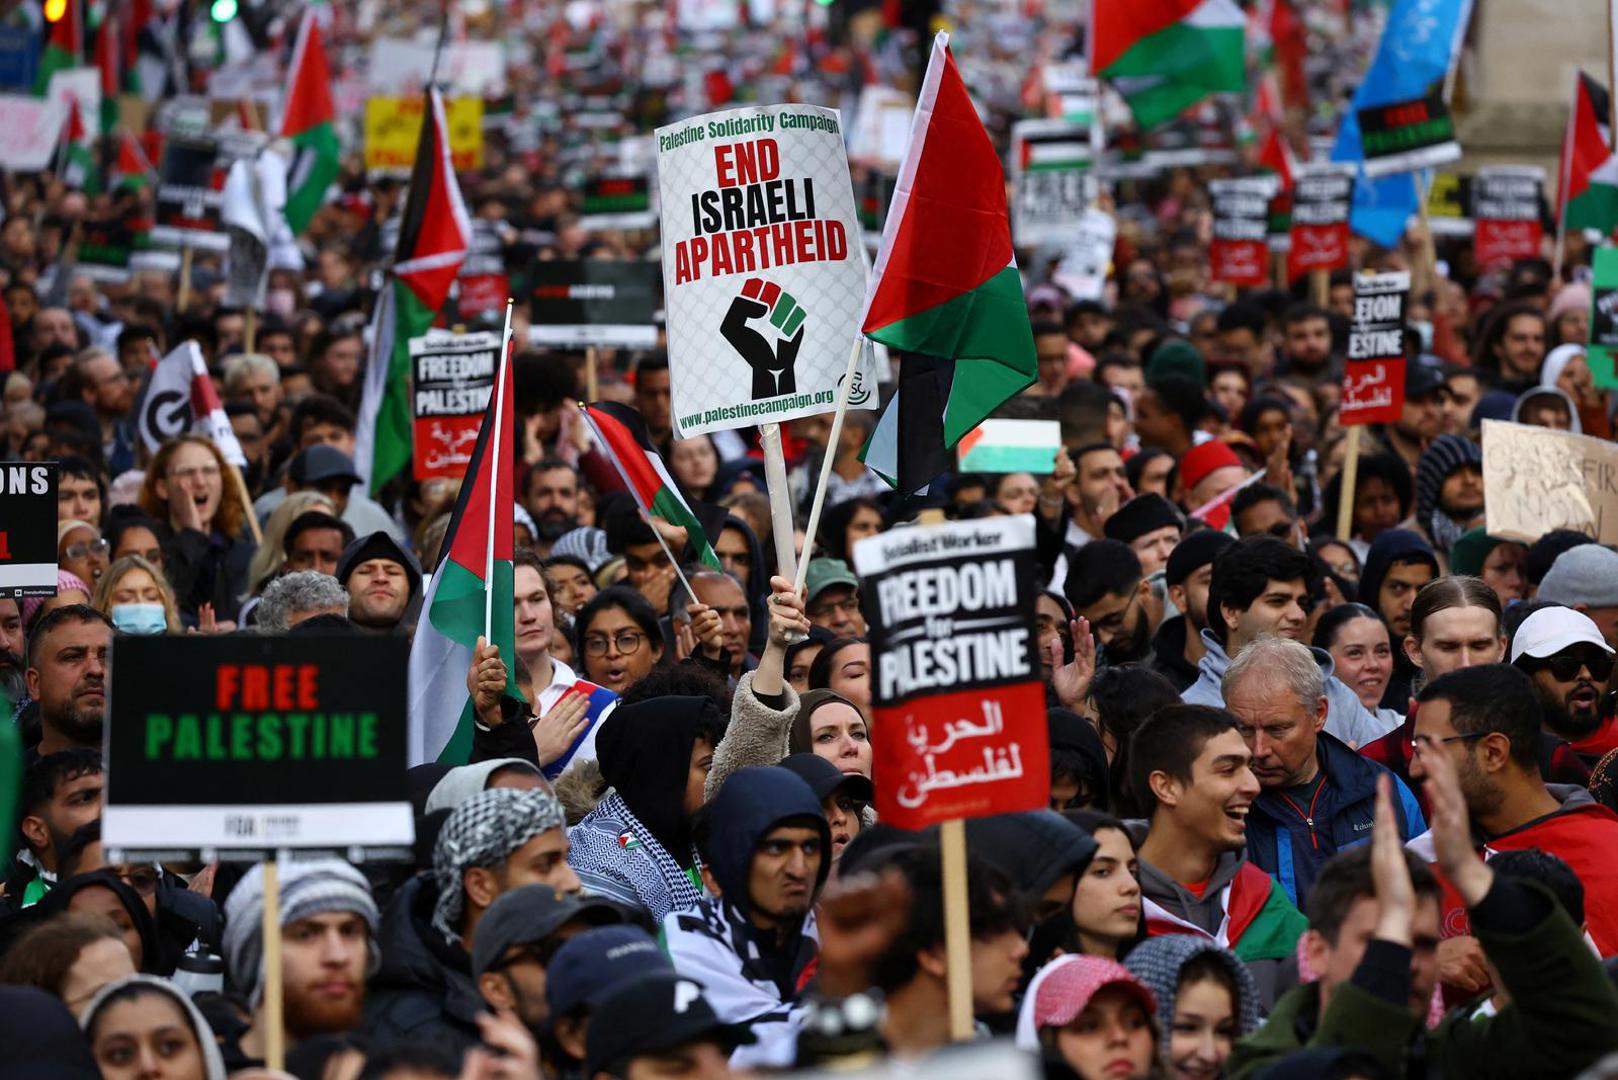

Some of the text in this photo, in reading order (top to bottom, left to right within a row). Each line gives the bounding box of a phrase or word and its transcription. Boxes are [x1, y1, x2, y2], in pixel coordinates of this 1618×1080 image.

[659, 111, 840, 153] Palestine Solidarity Campaign
[714, 138, 781, 189] END
[691, 178, 816, 236] ISRAELI
[675, 219, 848, 286] APARTHEID
[418, 352, 495, 382] FREEDOM
[416, 384, 493, 417] PALESTIN
[680, 389, 834, 430] www.palestinecampaign.org
[0, 466, 49, 495] NS
[215, 664, 321, 712] FREE
[144, 712, 380, 761] PALESTINE
